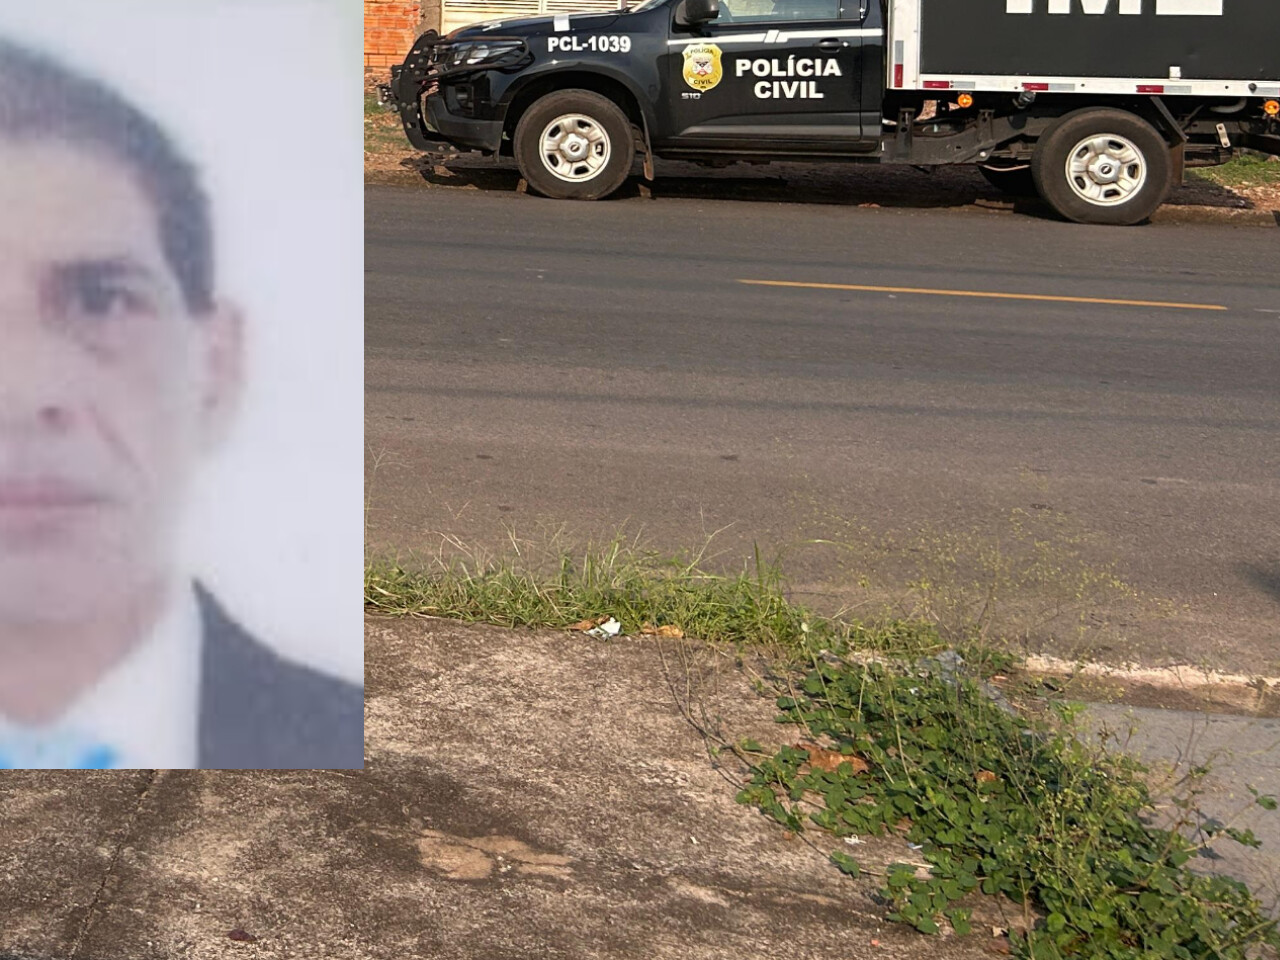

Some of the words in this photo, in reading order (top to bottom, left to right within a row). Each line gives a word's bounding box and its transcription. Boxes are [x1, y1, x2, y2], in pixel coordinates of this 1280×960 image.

[547, 35, 632, 53] PCL-1039
[735, 54, 842, 77] POLÍCIA
[681, 92, 702, 100] S10
[754, 81, 824, 99] CIVIL
